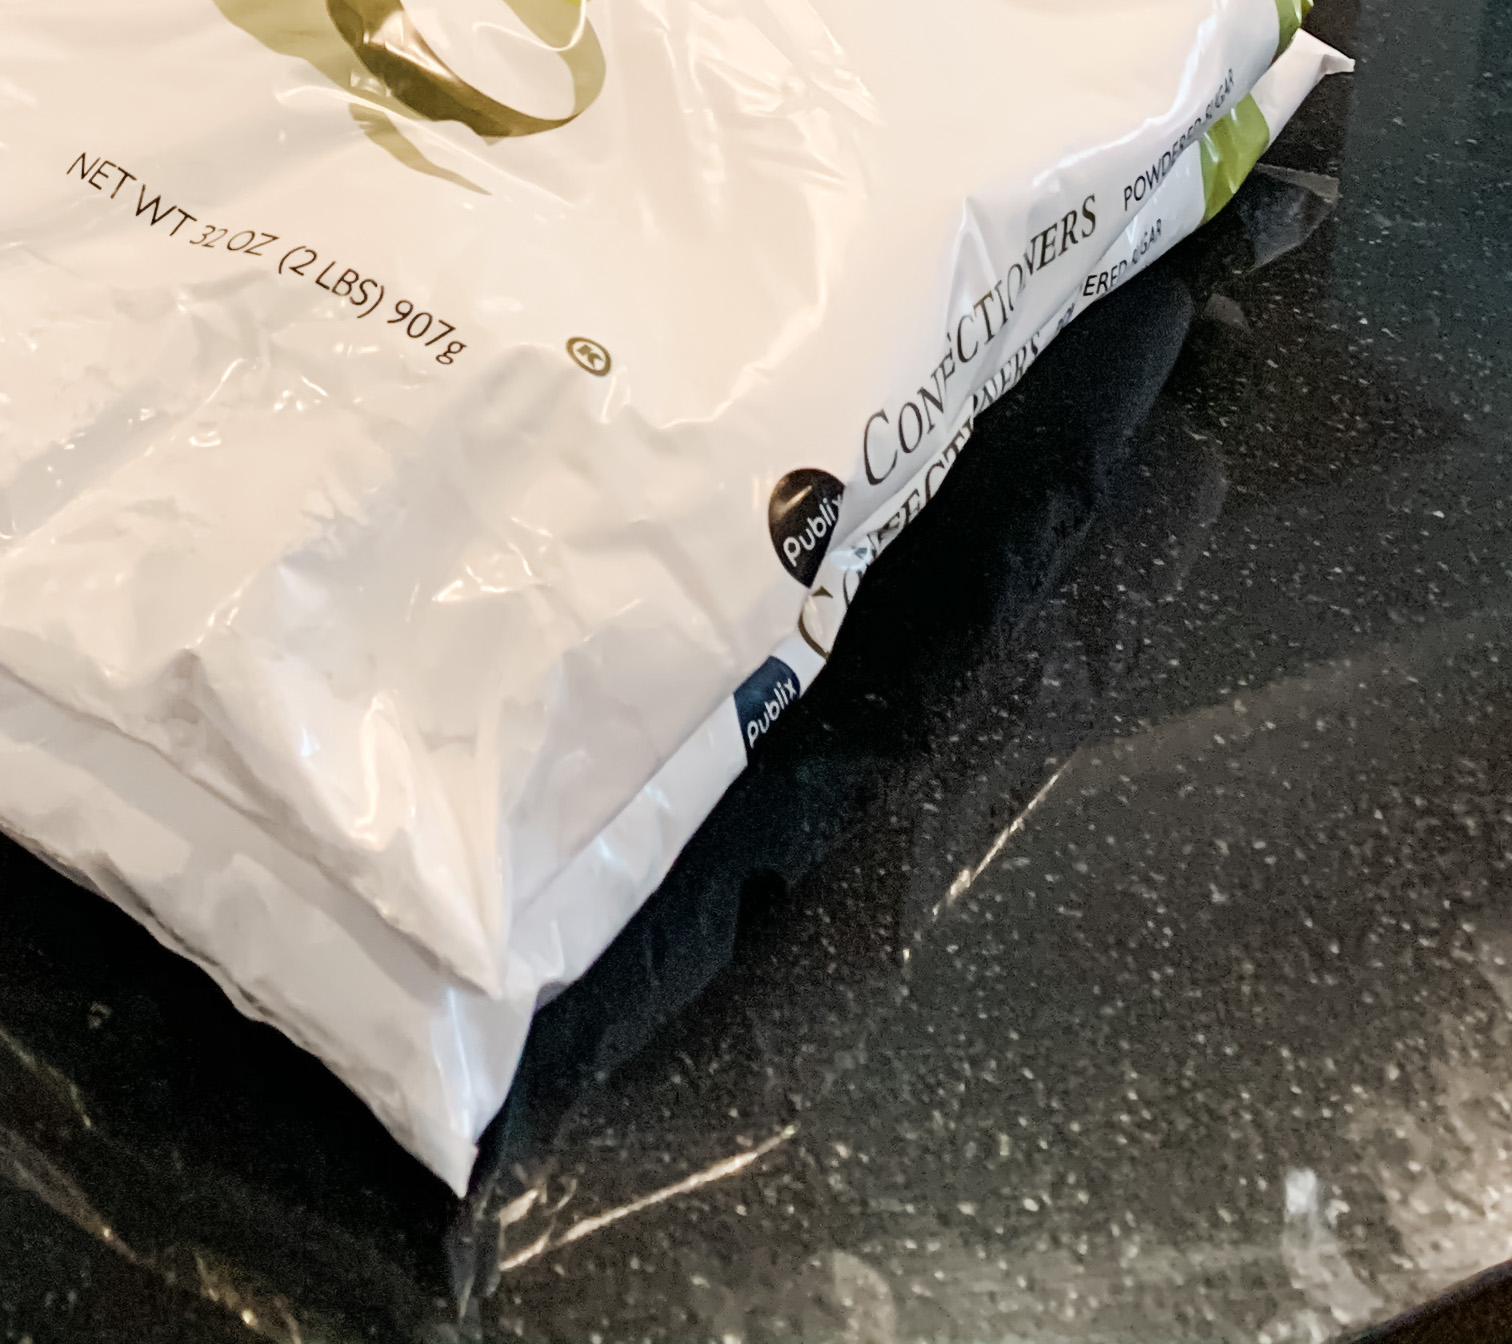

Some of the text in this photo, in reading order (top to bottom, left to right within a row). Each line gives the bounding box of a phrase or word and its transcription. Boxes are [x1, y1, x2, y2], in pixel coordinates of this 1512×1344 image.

[65, 151, 469, 367] NET WT 32 OZ (2 LBS) 907g
[746, 677, 798, 749] Publix
